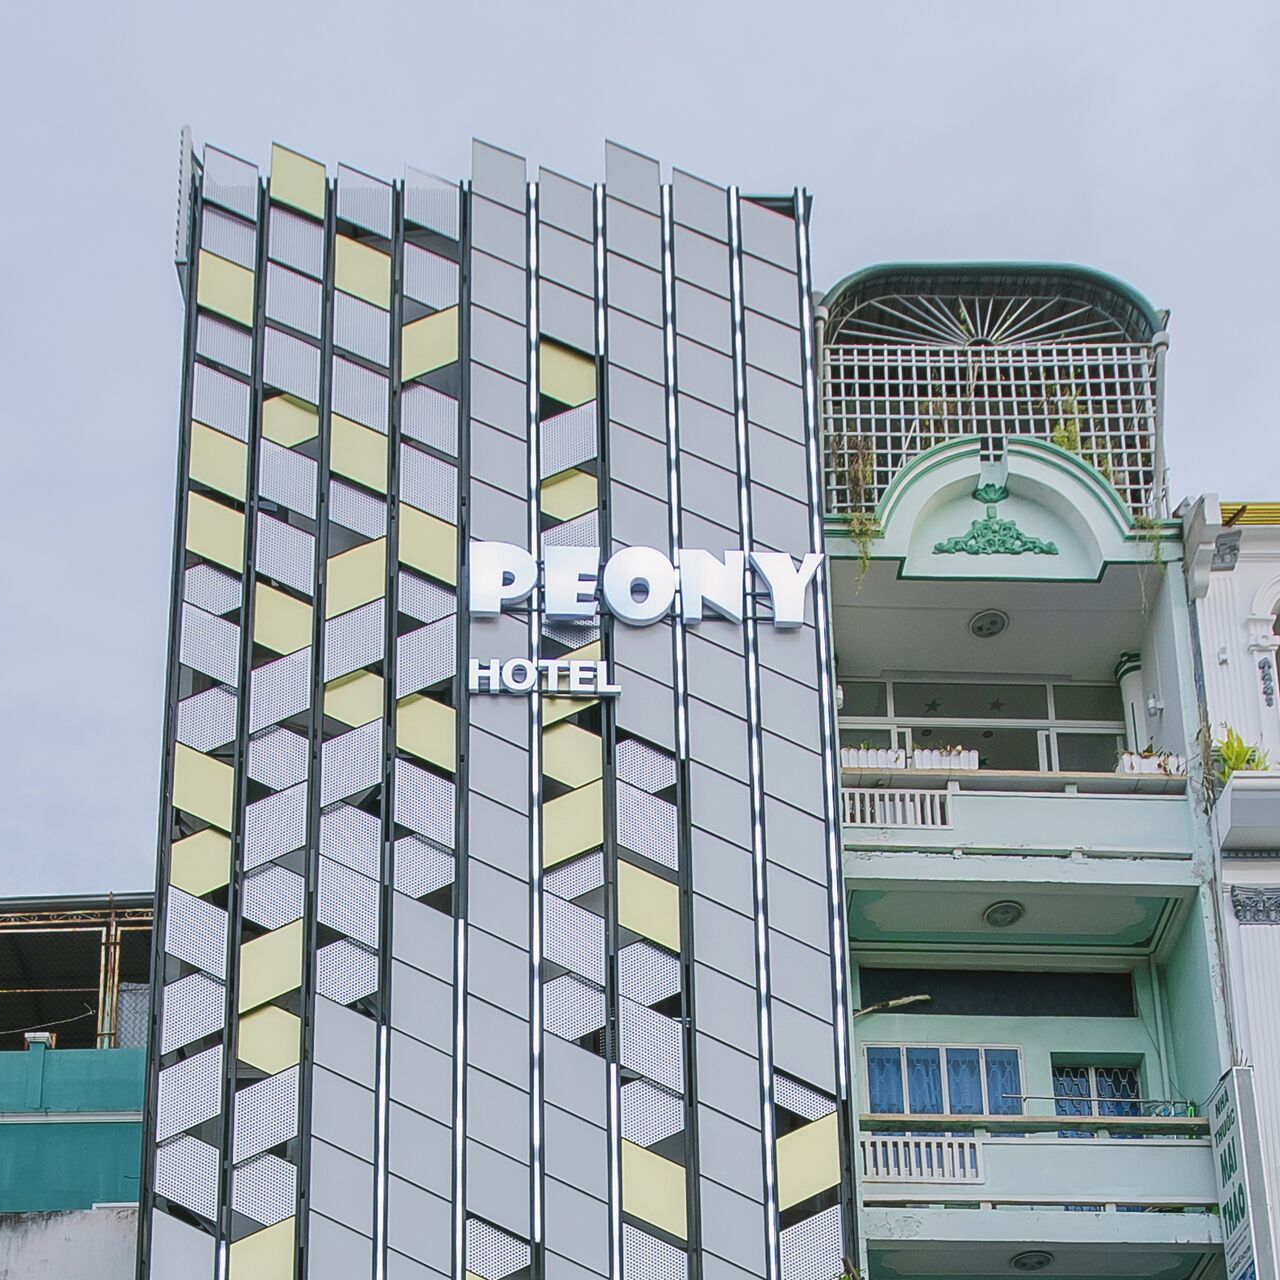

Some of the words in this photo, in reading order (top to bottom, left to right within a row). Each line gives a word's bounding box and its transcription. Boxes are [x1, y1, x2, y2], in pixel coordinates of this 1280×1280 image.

[469, 541, 825, 628] PEONY
[469, 657, 622, 696] HOTEL
[1215, 1085, 1230, 1120] NHÀ
[1220, 1135, 1238, 1189] MAI
[1222, 1181, 1247, 1240] THẢO
